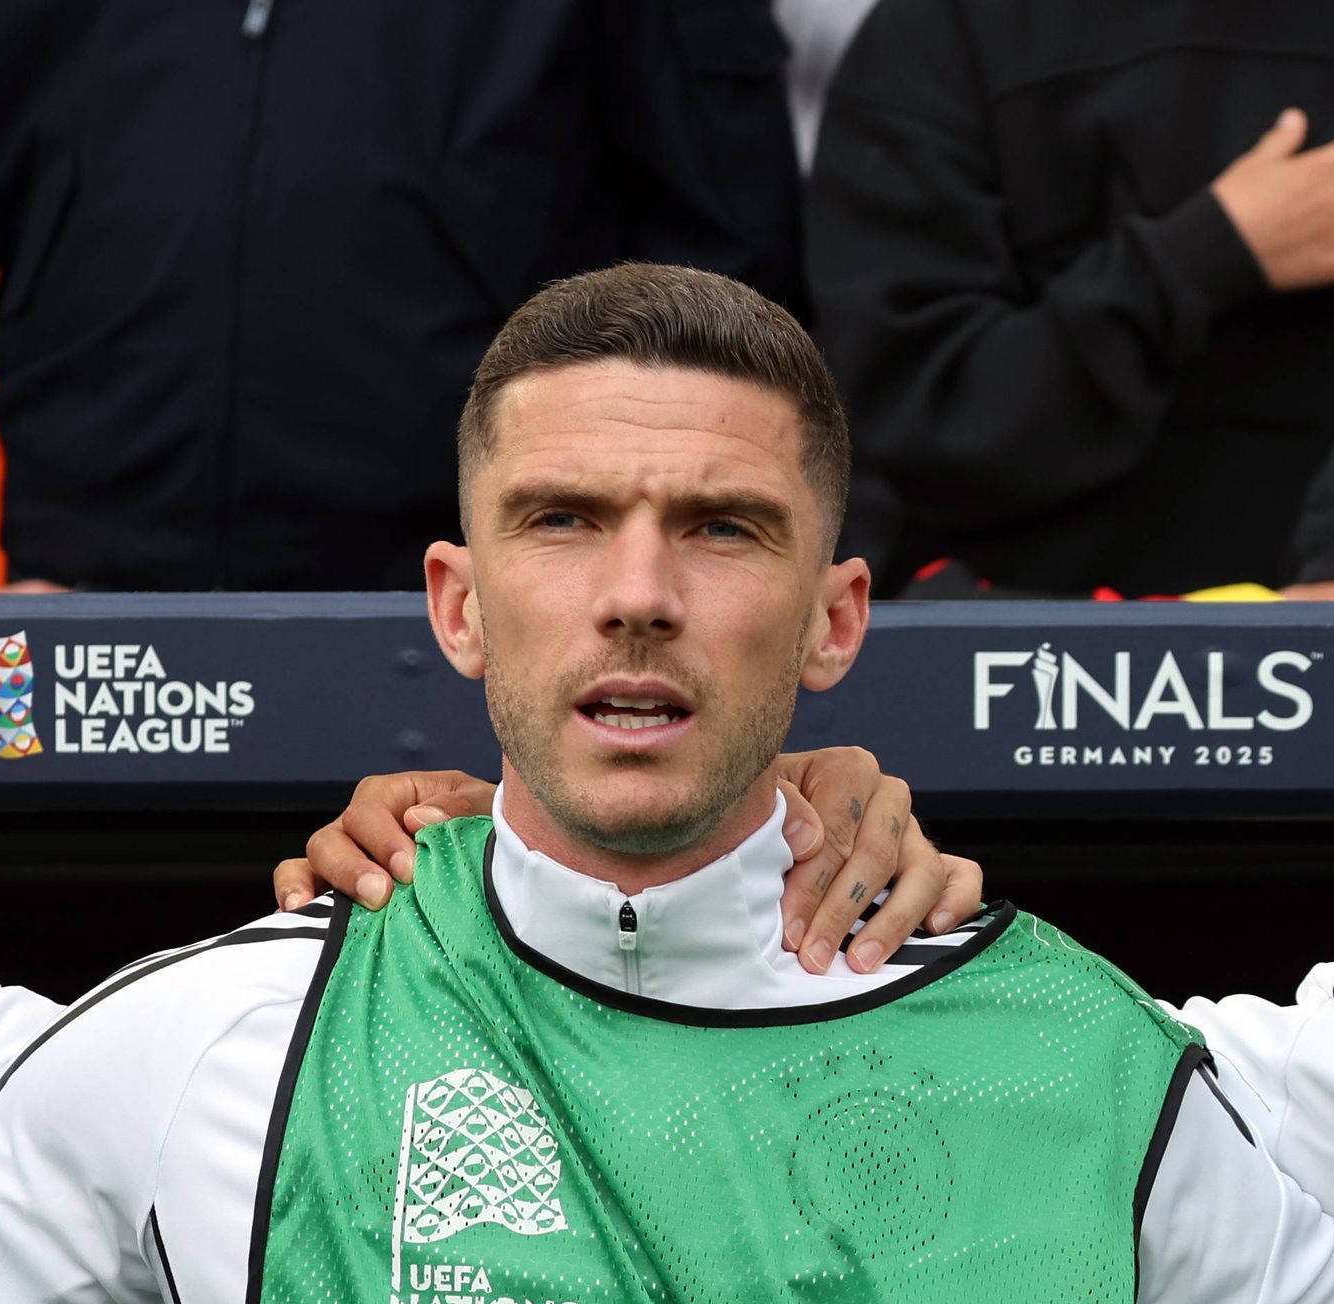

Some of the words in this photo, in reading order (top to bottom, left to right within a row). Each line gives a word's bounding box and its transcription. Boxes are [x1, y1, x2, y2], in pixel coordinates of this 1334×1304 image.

[54, 644, 167, 678] UEFA
[54, 681, 255, 716] NATIONS
[1013, 746, 1176, 766] GERMANY
[1194, 746, 1275, 766] 2025
[409, 1263, 492, 1293] UEFA
